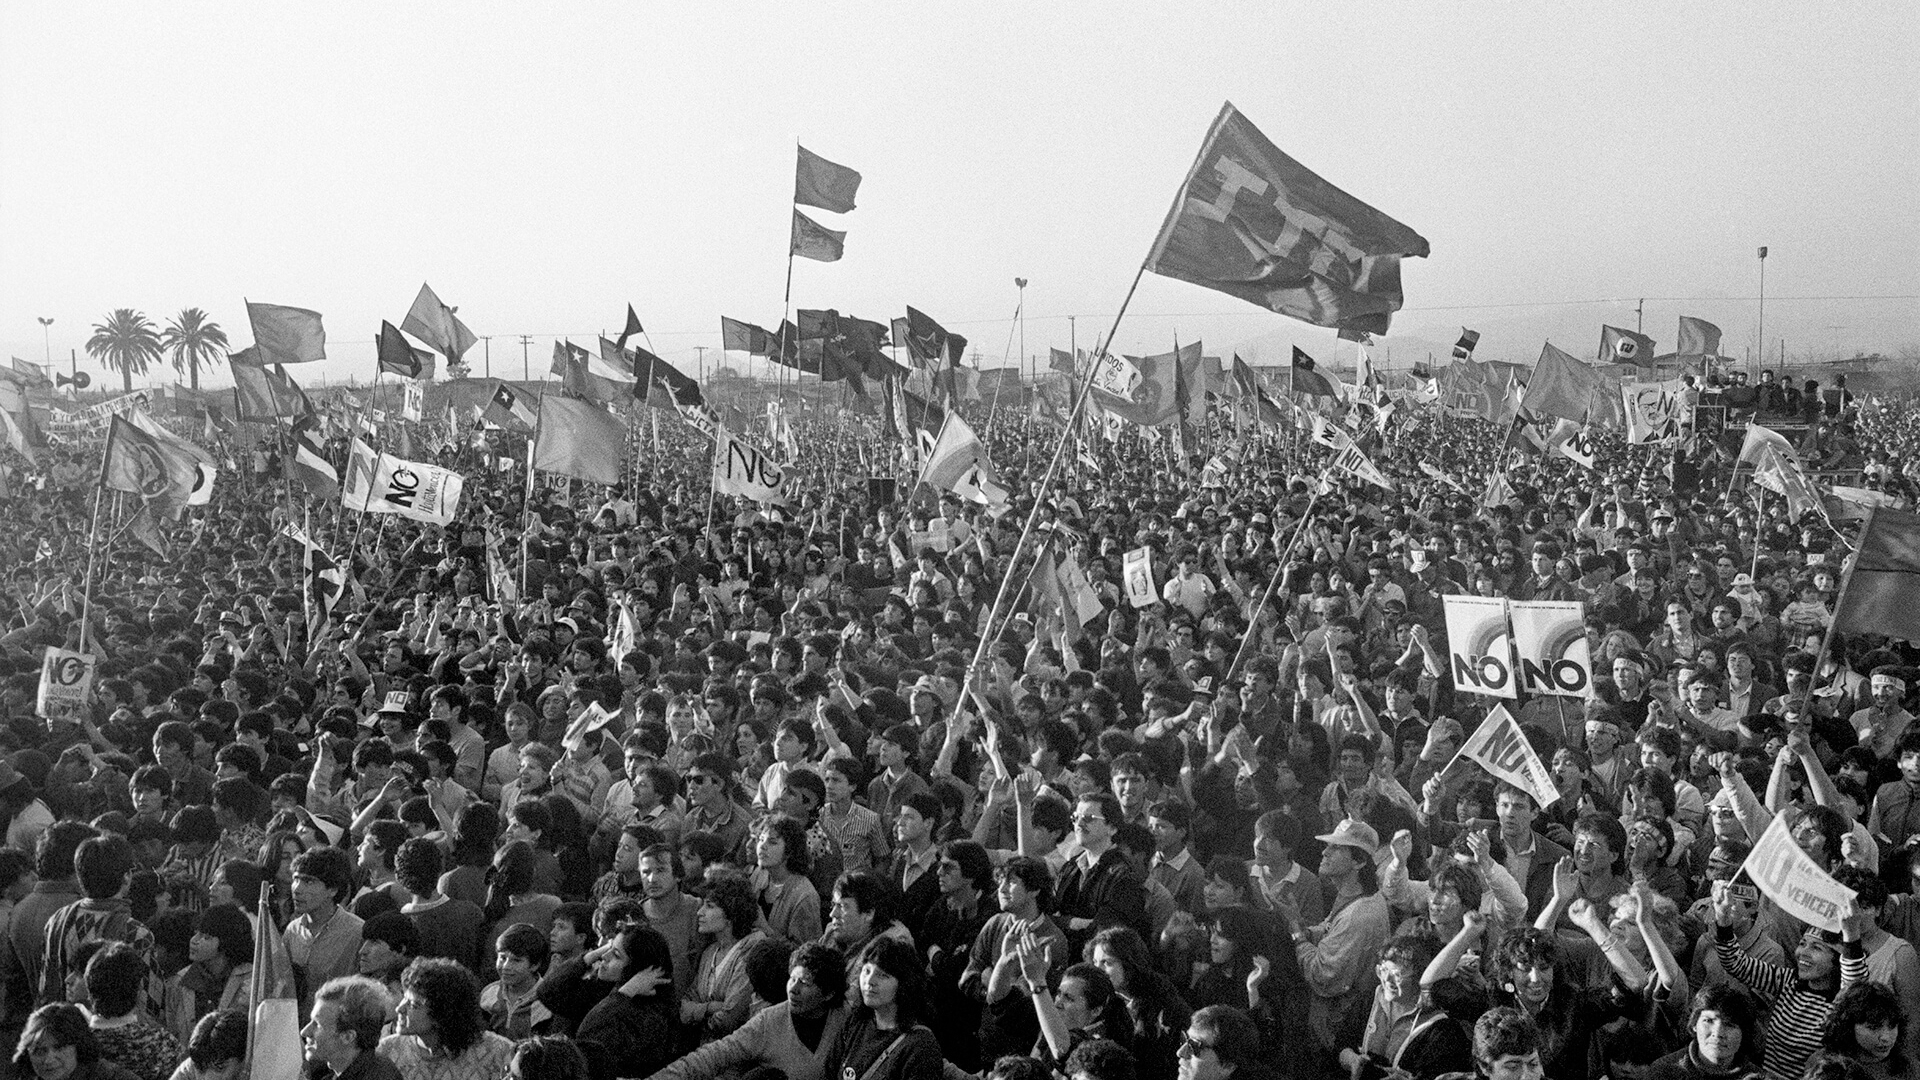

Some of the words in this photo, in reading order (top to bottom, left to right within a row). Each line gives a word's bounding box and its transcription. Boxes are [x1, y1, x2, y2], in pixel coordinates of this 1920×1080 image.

[1094, 347, 1124, 372] UiDOS
[1321, 422, 1337, 443] NO
[1567, 431, 1593, 458] NO
[727, 440, 781, 488] NO
[1340, 447, 1364, 472] NO
[385, 469, 419, 508] NO
[44, 656, 86, 686] NO
[1453, 652, 1509, 690] NO
[1522, 657, 1587, 692] NO
[386, 691, 408, 705] NO
[1788, 883, 1839, 919] VENCER
